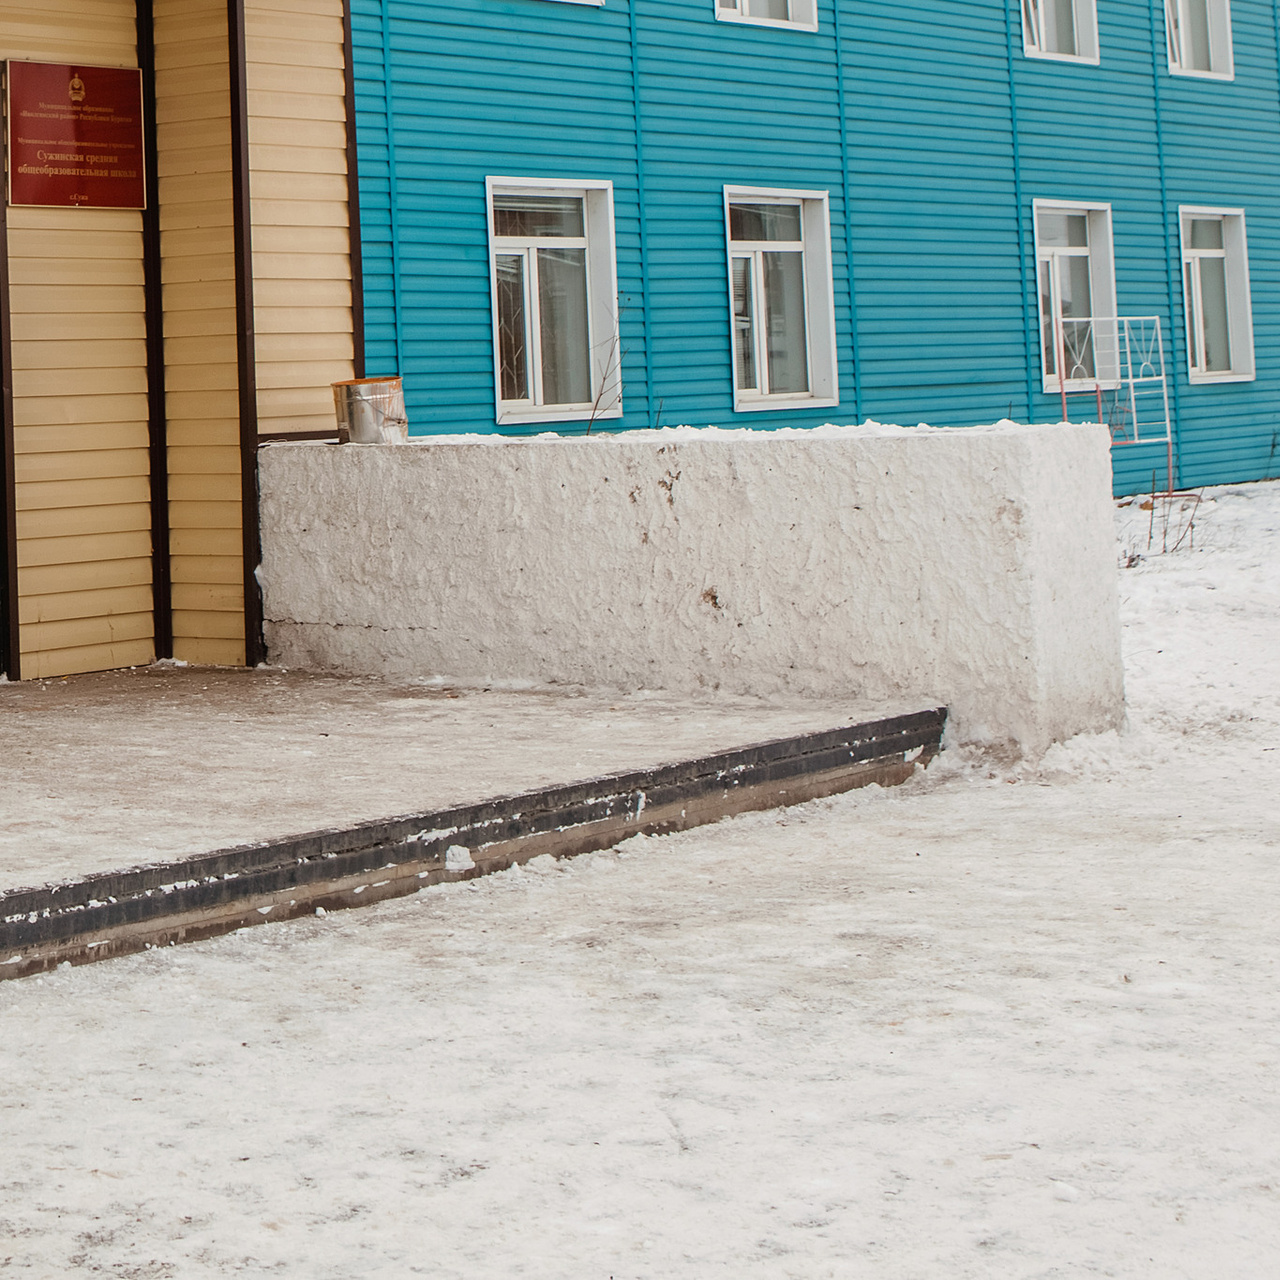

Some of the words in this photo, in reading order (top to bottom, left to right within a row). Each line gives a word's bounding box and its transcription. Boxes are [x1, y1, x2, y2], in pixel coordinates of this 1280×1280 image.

[37, 150, 84, 162] Сужинская
[86, 154, 118, 164] средняя
[18, 164, 108, 177] общеобразовательная
